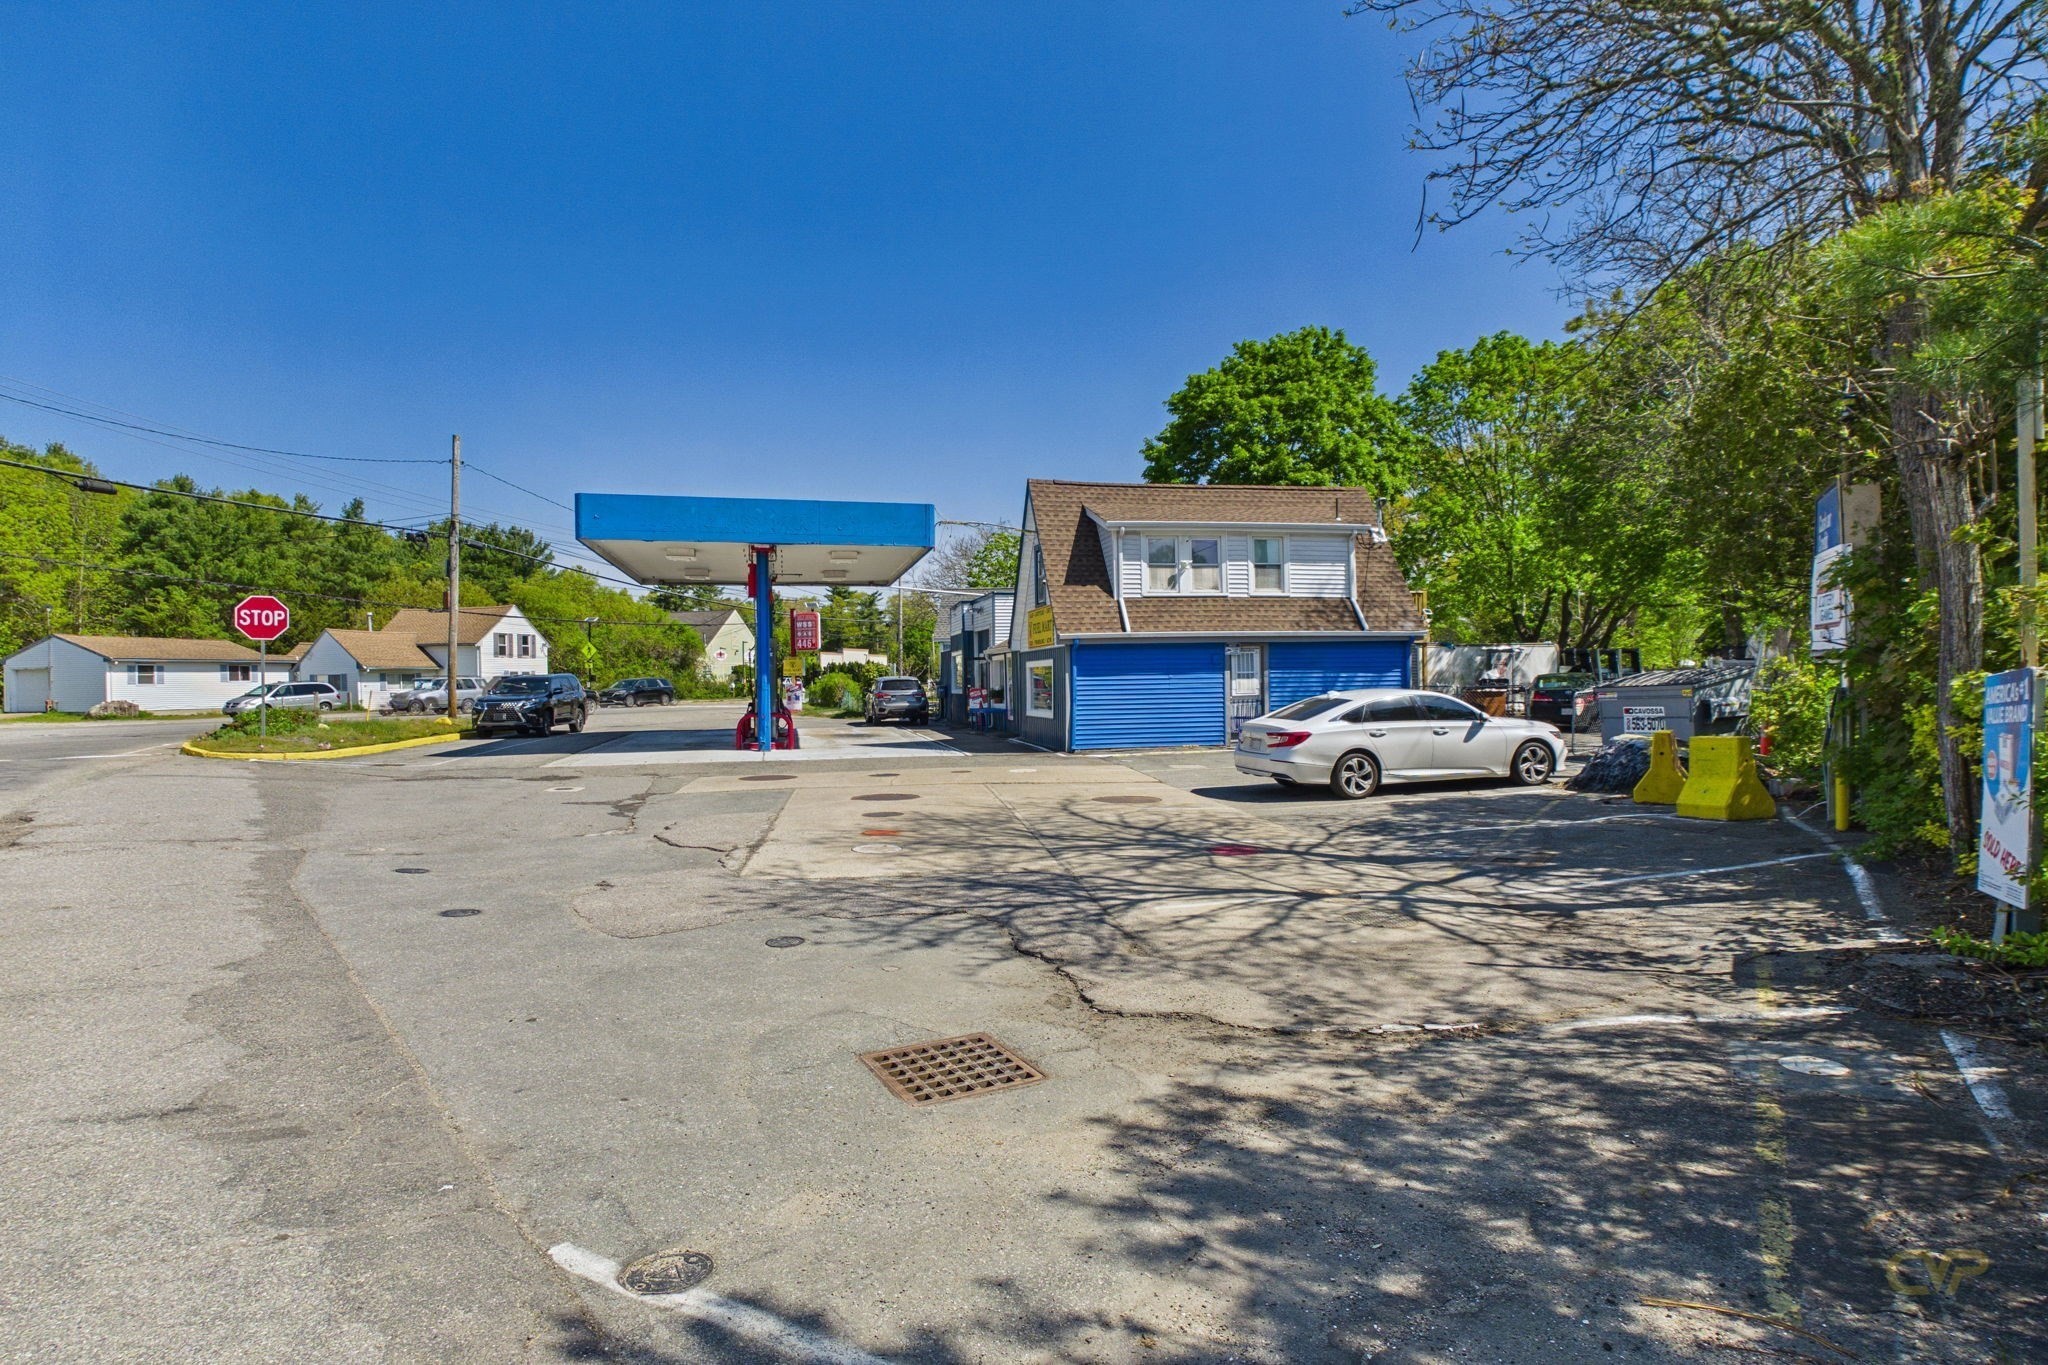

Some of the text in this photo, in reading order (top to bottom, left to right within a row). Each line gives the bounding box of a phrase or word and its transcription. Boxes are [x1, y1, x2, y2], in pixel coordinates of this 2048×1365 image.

[239, 609, 285, 626] STOP
[2004, 703, 2028, 723] BRAND
[1631, 716, 1665, 730] 563-5070
[1983, 830, 2000, 858] SOLD
